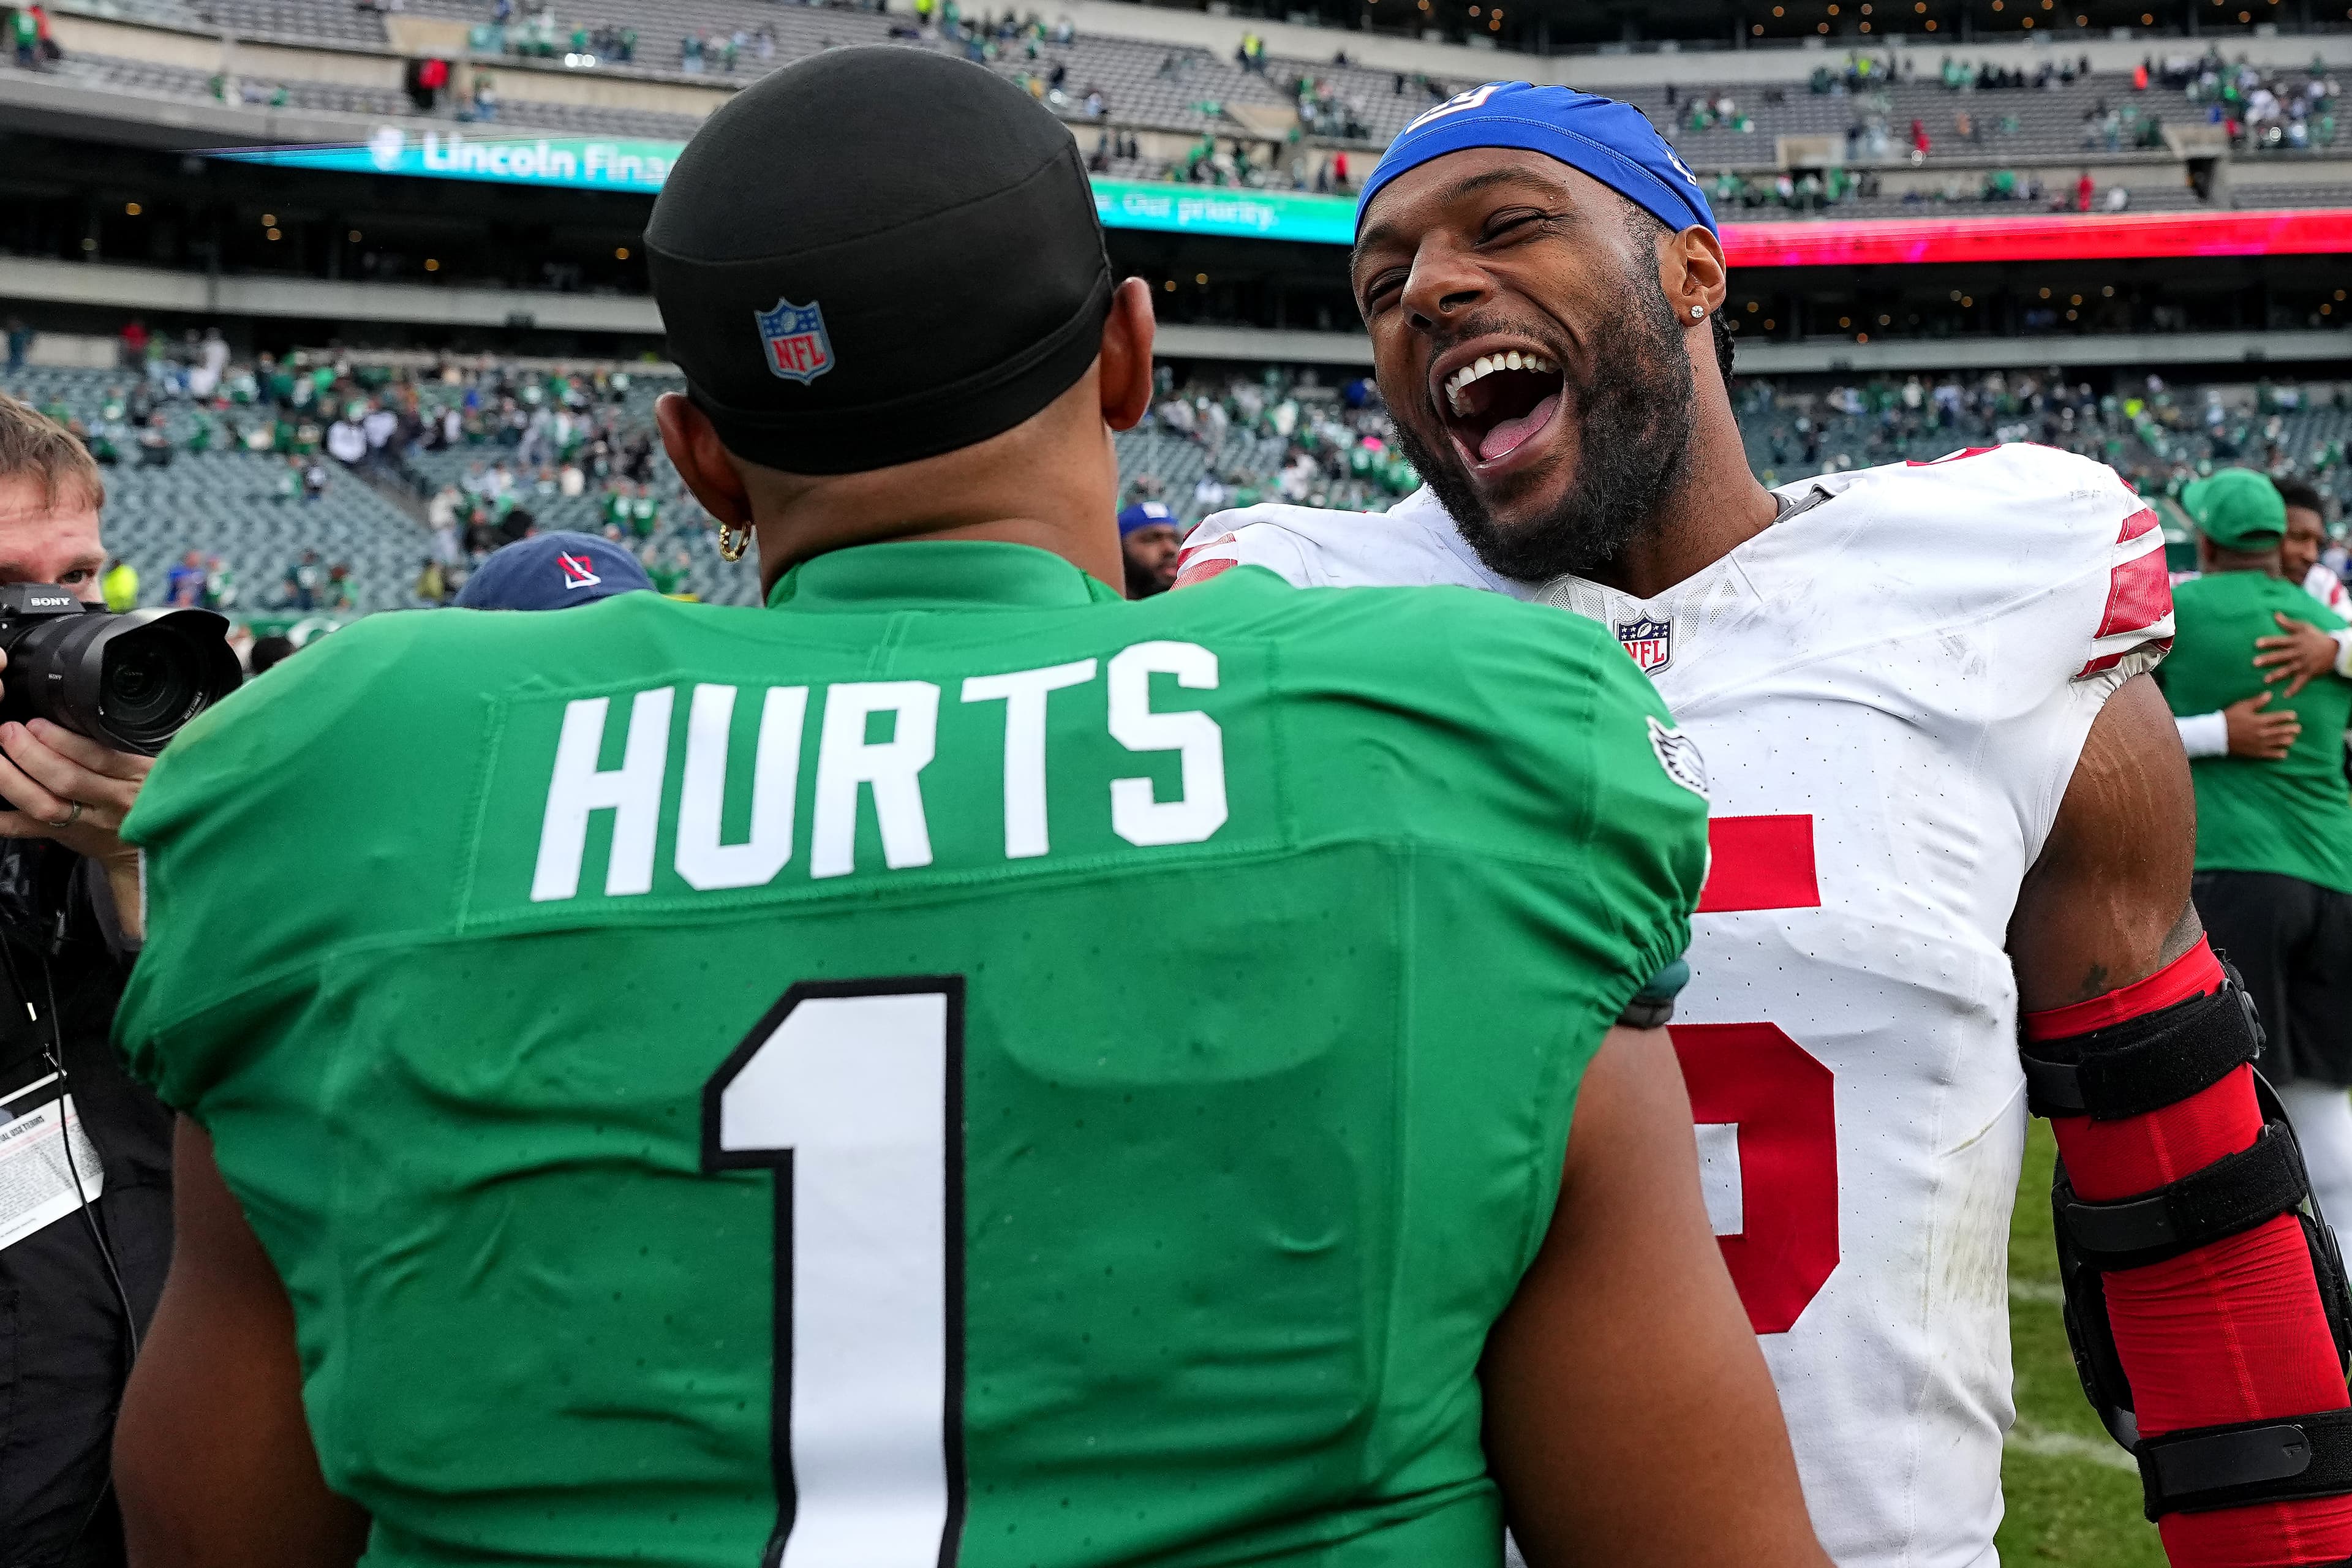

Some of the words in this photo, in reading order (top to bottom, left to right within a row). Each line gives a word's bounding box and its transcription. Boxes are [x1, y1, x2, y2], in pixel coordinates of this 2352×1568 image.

[424, 130, 577, 179] Lincoln
[584, 143, 675, 184] Fina
[772, 334, 826, 372] NFL
[31, 597, 70, 606] SONY
[1623, 640, 1665, 668] NFL
[530, 639, 1229, 902] HURTS
[699, 973, 967, 1568] 1
